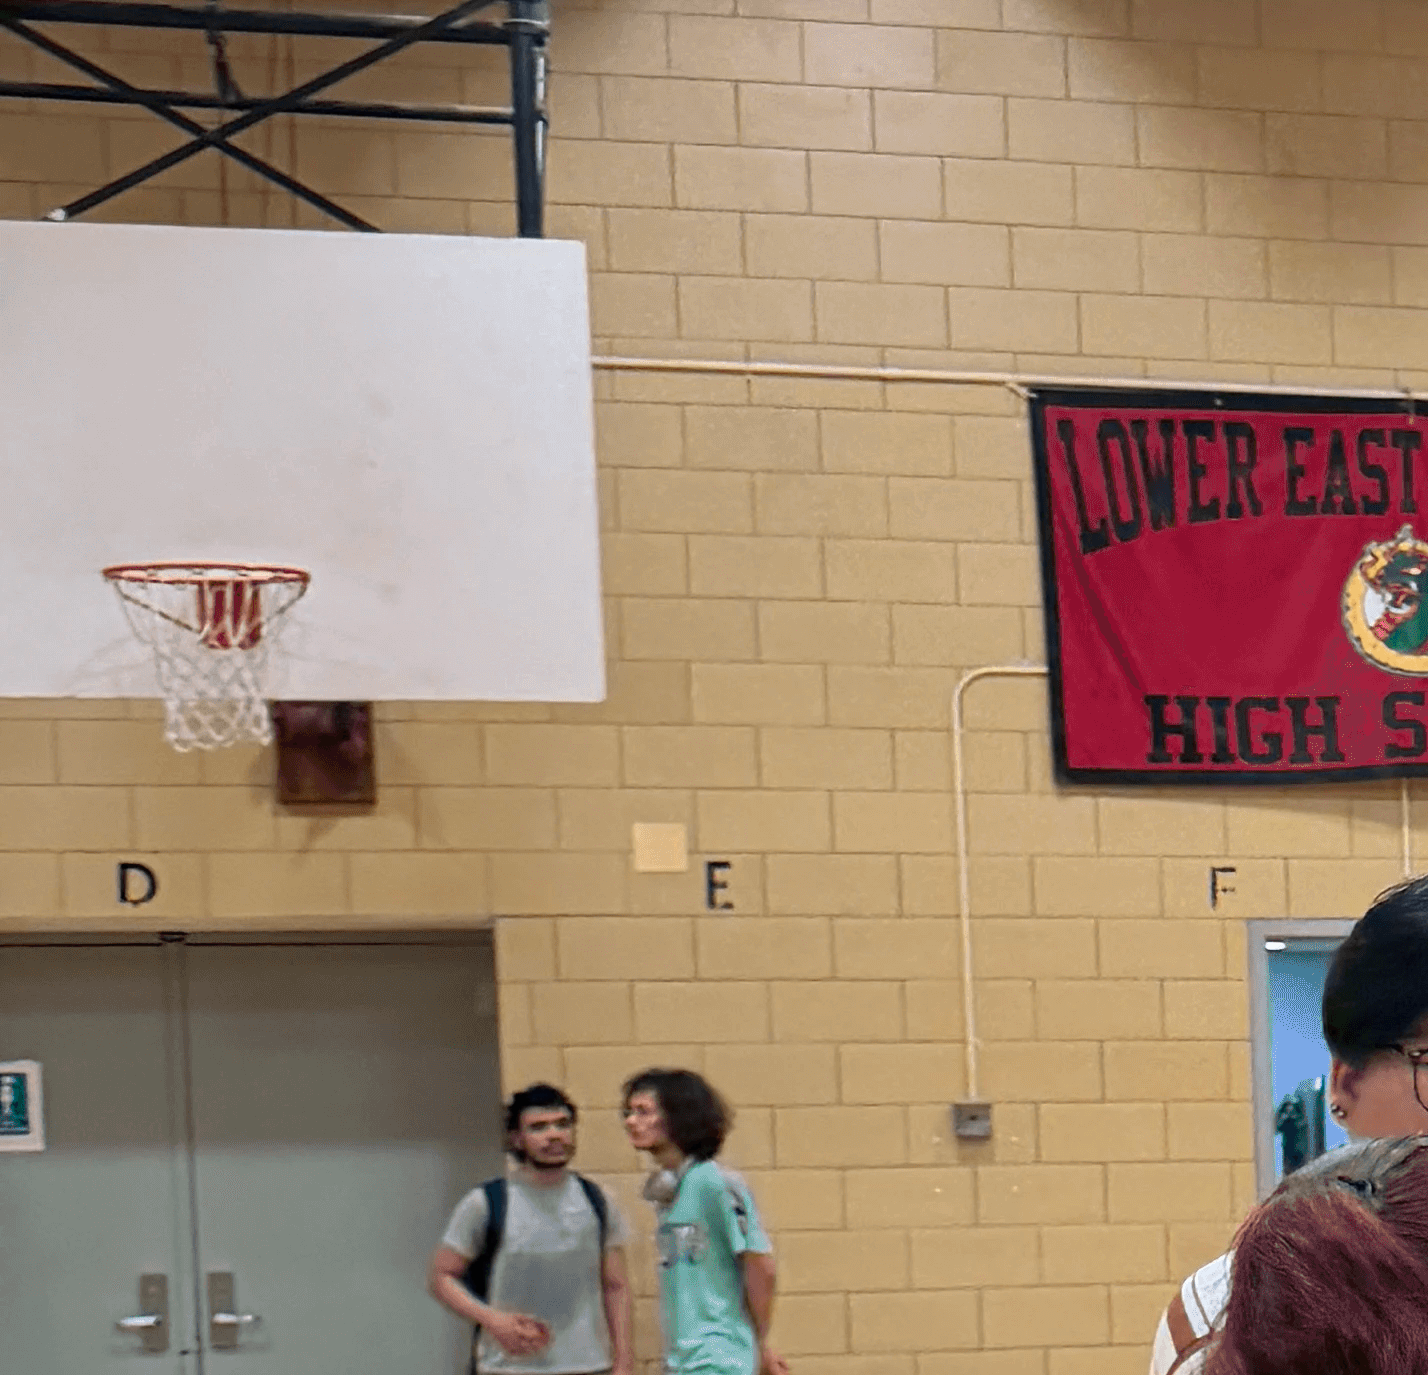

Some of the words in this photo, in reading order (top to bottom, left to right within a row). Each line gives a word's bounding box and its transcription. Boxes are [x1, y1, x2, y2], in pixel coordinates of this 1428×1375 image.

[1056, 418, 1263, 557] LOWER
[1283, 426, 1423, 517] EAST
[1143, 694, 1346, 766] HIGH
[119, 862, 157, 904] D
[706, 861, 735, 909] E
[1209, 867, 1237, 910] F
